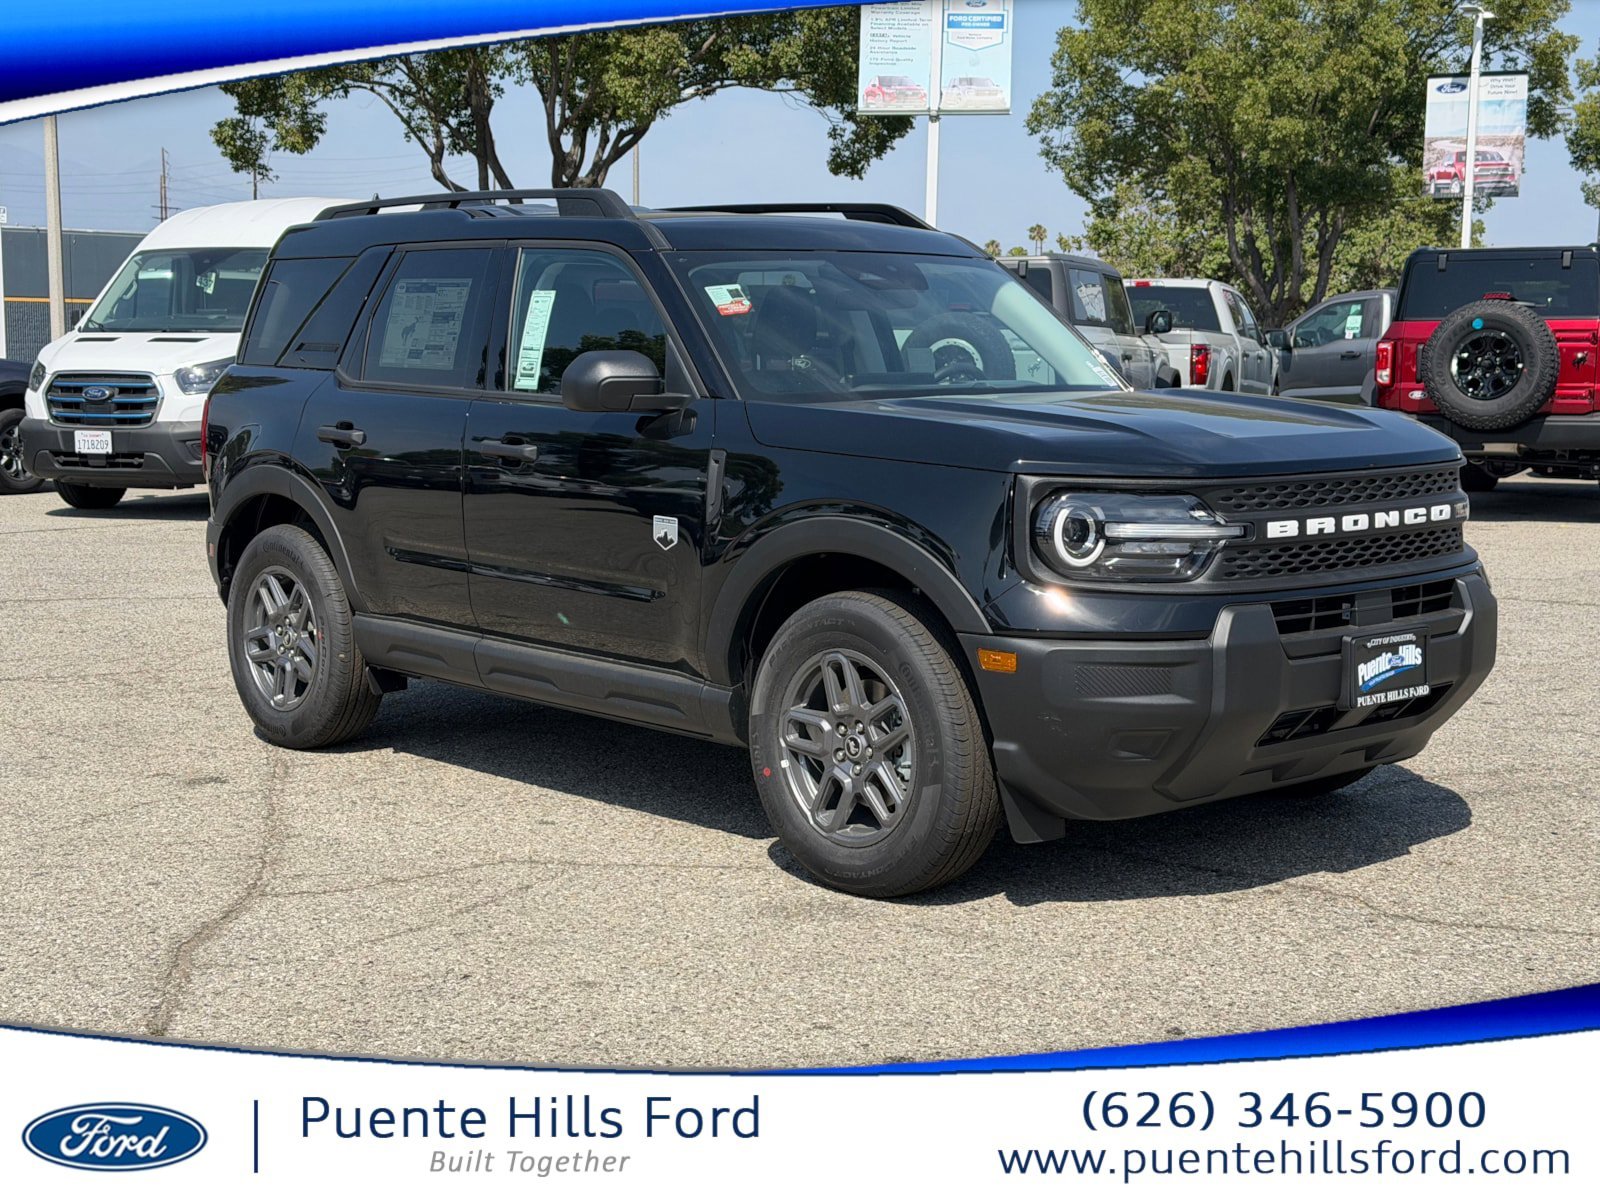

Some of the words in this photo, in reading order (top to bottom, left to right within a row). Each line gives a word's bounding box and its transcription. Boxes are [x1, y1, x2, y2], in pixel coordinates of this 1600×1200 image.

[1440, 83, 1463, 93] Ford
[77, 439, 109, 450] 1718209
[1266, 504, 1451, 539] BRONCO
[1358, 651, 1393, 687] Puente
[1399, 644, 1423, 666] Hills
[1357, 692, 1386, 707] PUENTE
[1387, 688, 1409, 702] HILLS
[1409, 685, 1430, 698] FORD
